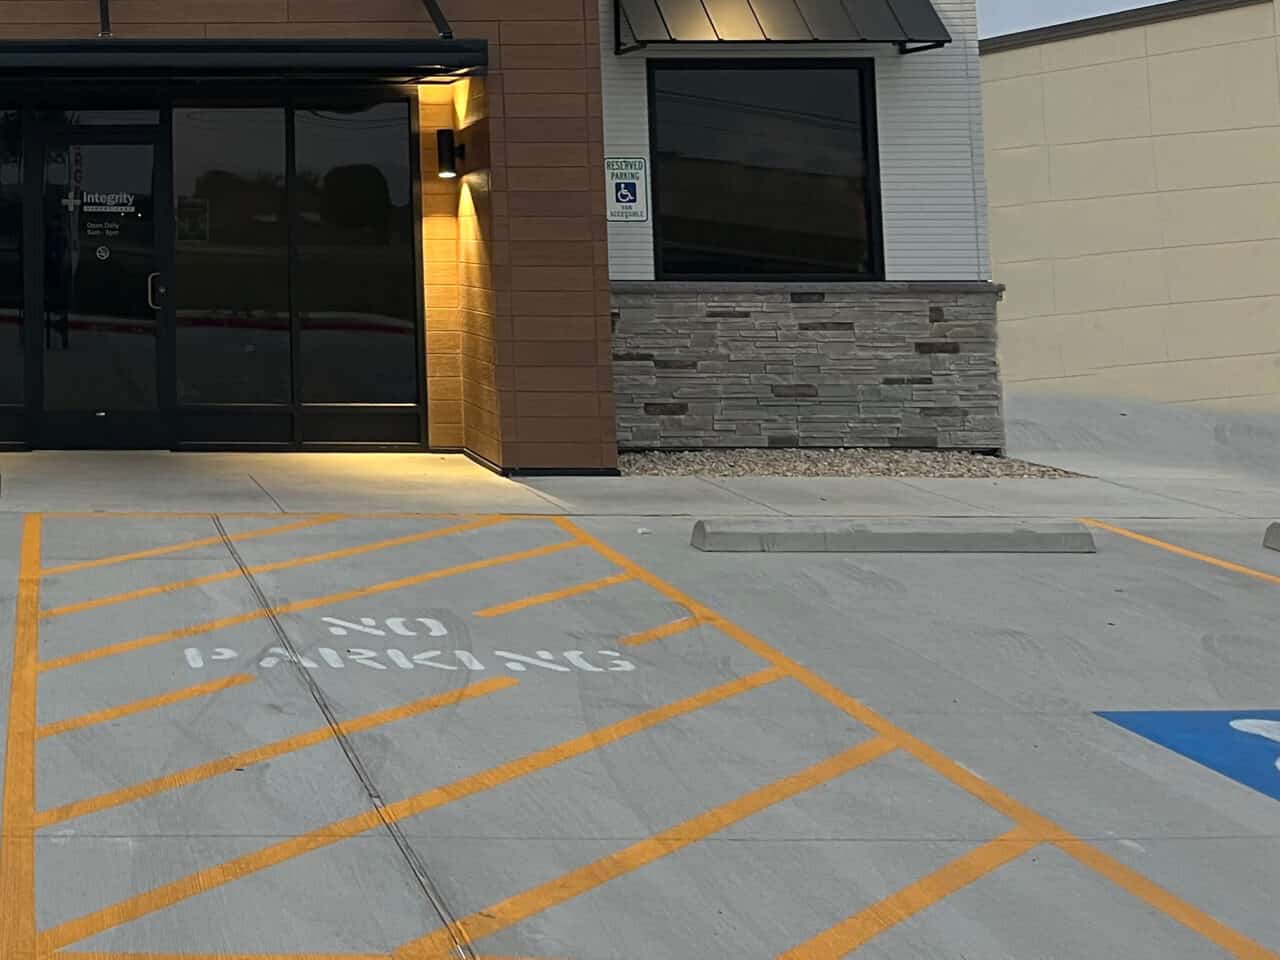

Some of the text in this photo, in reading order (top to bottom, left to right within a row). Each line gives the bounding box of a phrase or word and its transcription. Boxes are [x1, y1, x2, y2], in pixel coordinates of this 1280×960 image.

[606, 160, 643, 170] RESERVED
[610, 172, 640, 180] PARKING
[83, 191, 135, 205] Integrity
[321, 616, 449, 637] NO
[183, 646, 637, 672] PARKING
